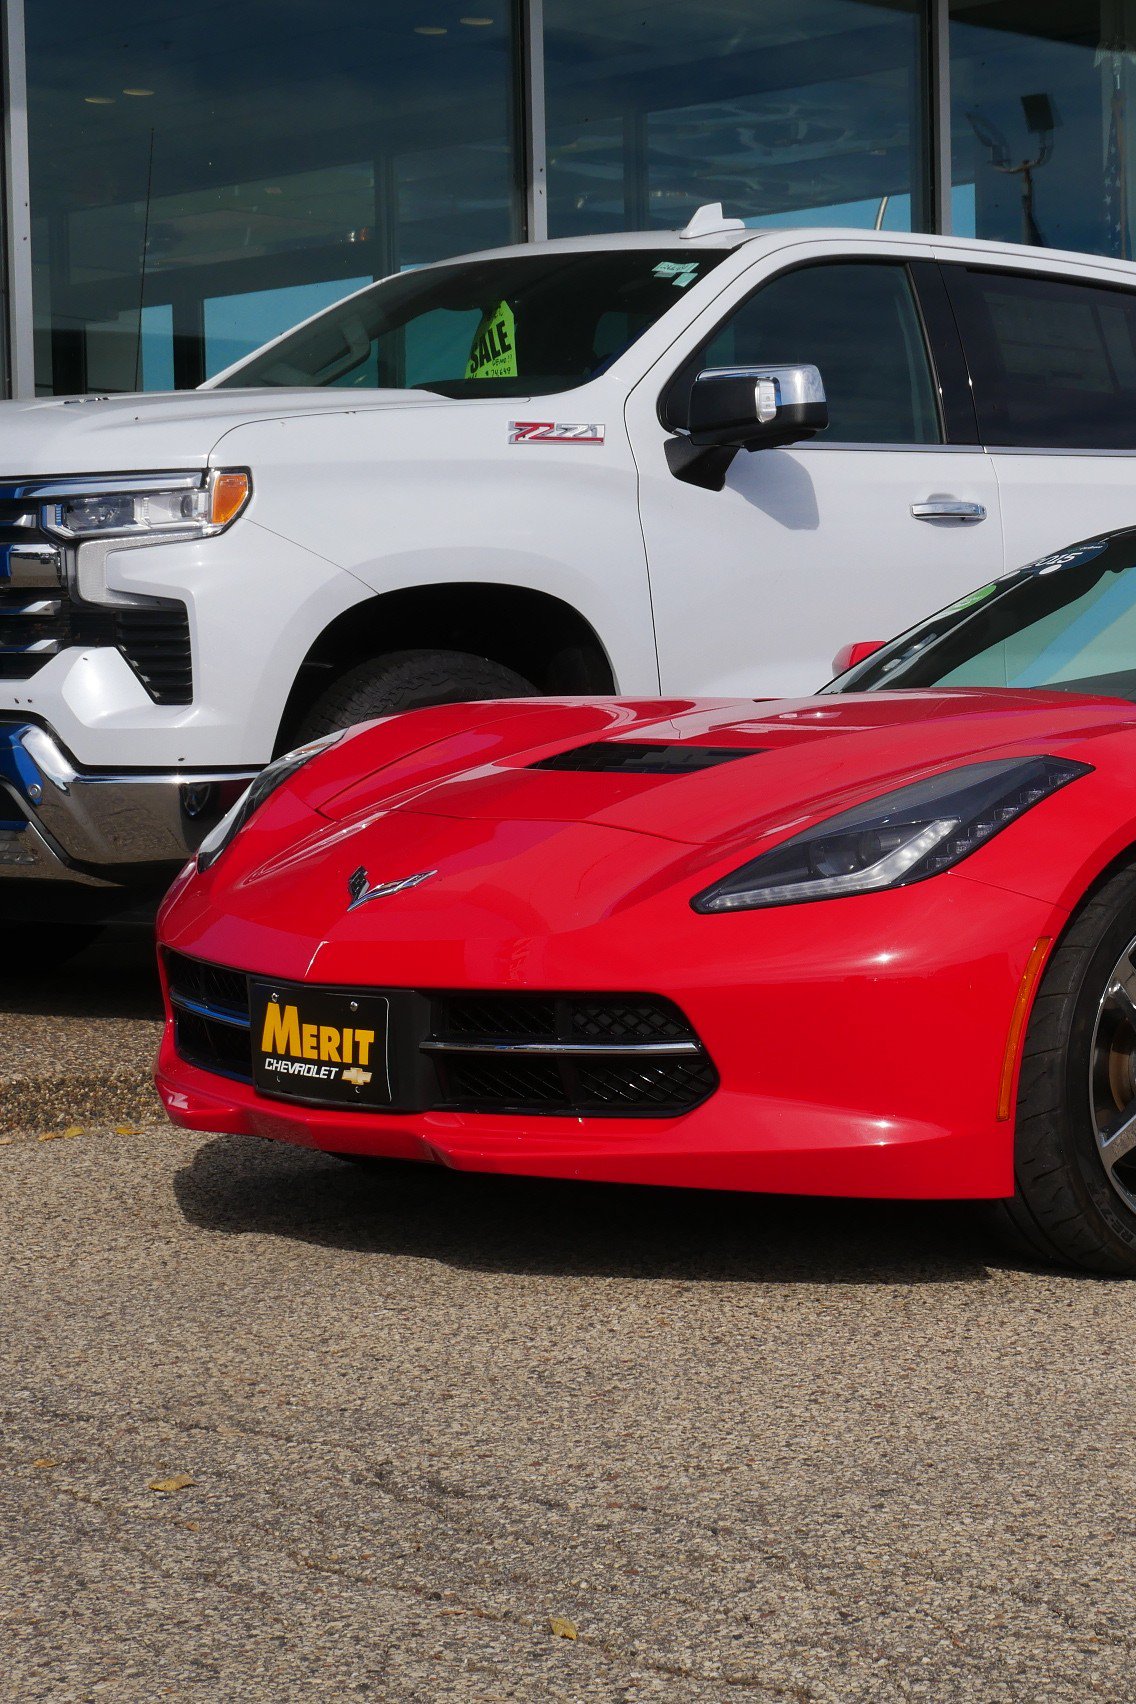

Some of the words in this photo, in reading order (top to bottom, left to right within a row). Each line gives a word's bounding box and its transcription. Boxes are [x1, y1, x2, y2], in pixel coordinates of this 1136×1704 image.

[471, 320, 512, 373] SALE
[507, 421, 605, 445] Z71
[261, 1002, 375, 1066] MERIT
[264, 1057, 339, 1080] CHEVROLET
